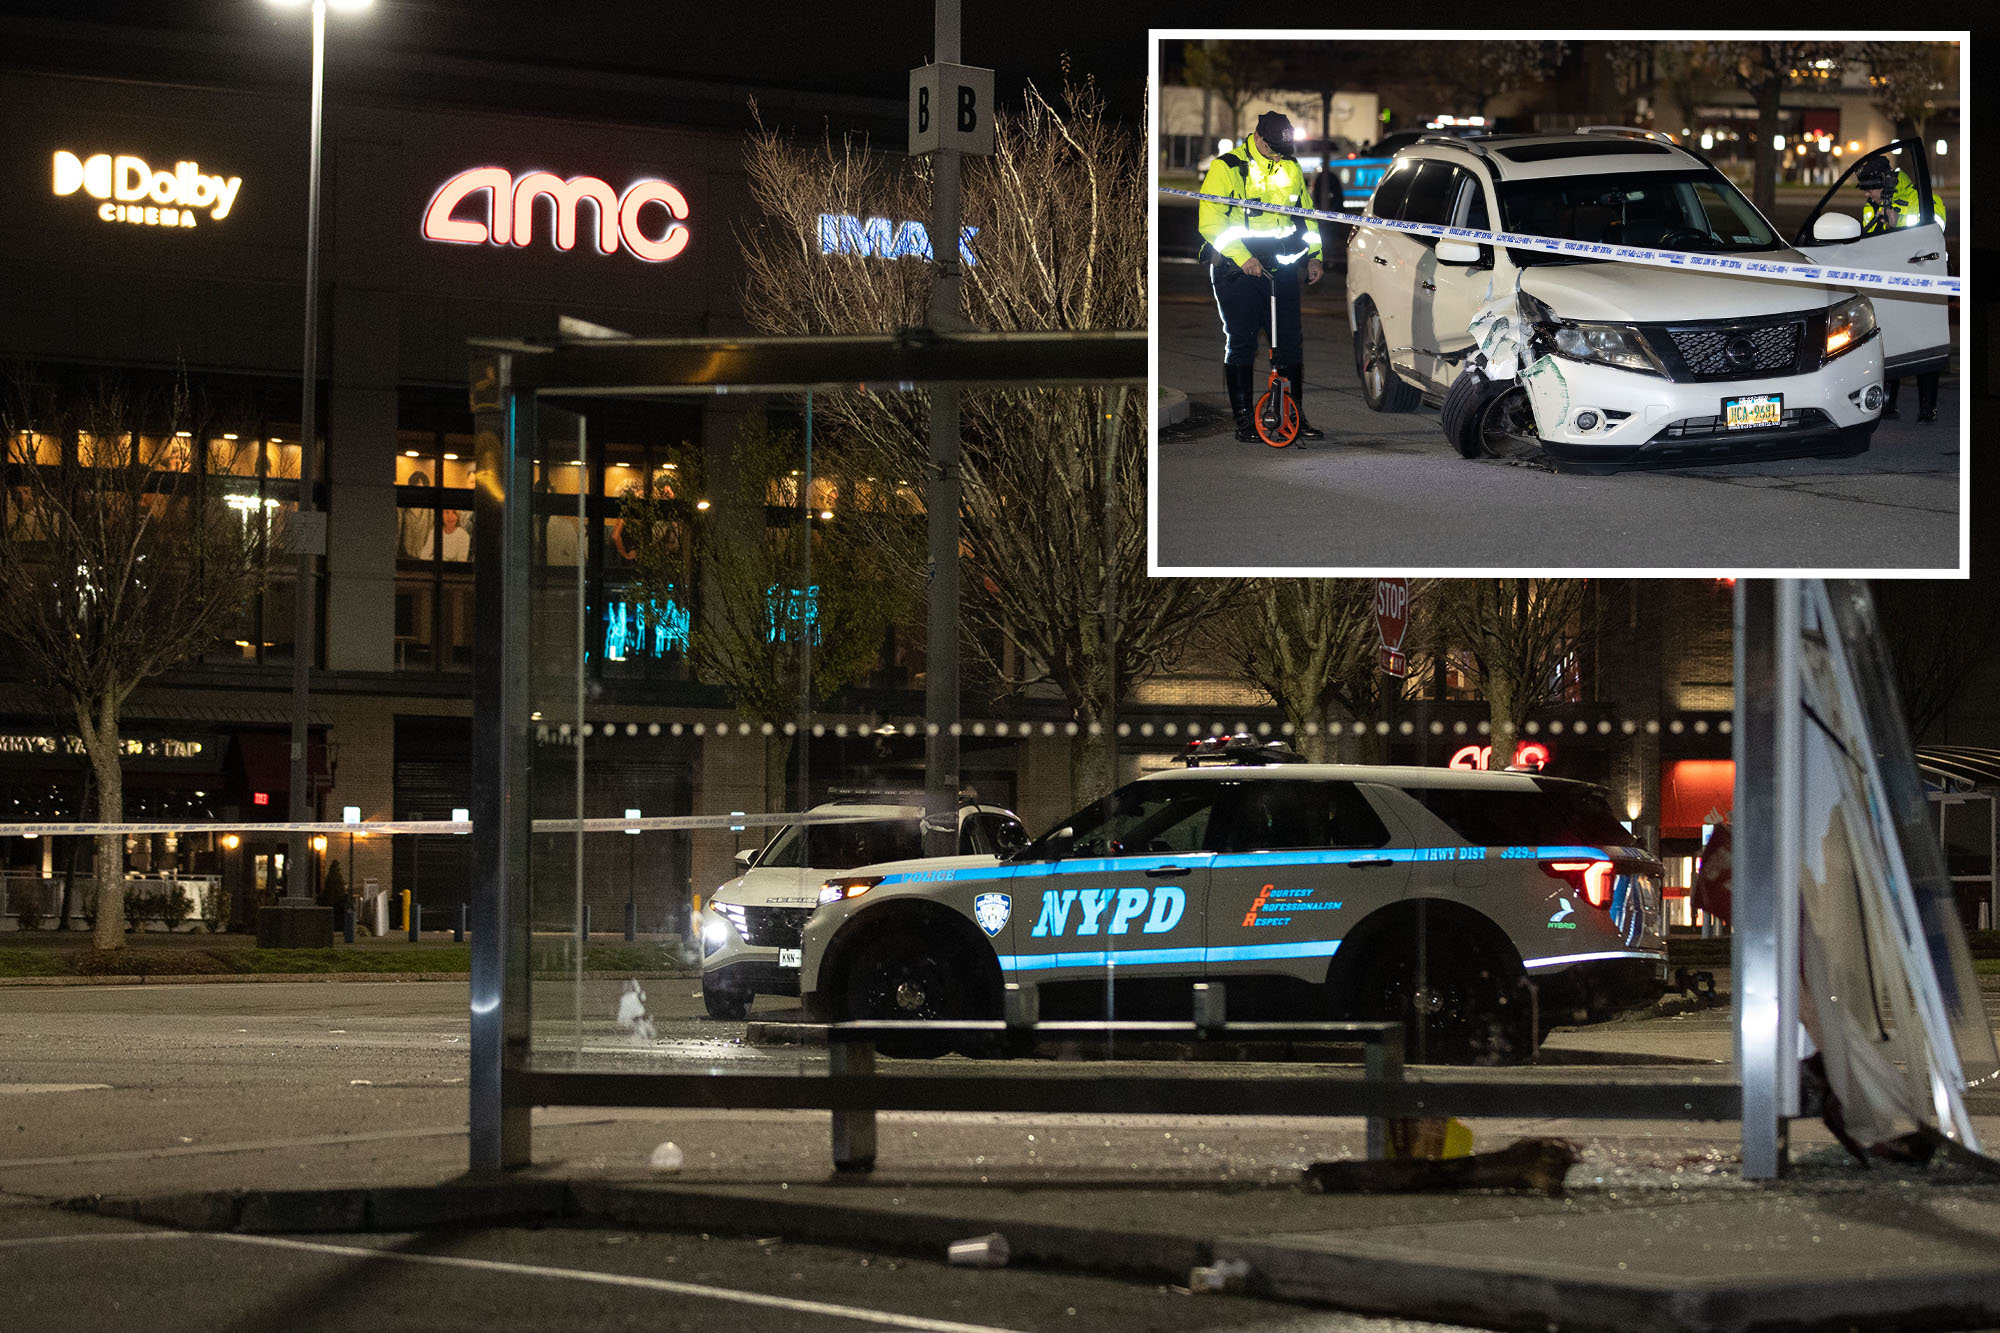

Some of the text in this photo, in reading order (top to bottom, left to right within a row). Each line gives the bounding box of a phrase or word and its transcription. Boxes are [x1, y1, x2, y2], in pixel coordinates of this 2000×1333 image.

[919, 86, 930, 134] B
[957, 85, 977, 132] B
[114, 155, 242, 220] Dolby
[98, 202, 197, 227] CINEMA
[1378, 581, 1405, 619] STOP
[162, 737, 202, 757] TAP
[1458, 846, 1487, 860] DIST
[902, 869, 956, 884] POLICE
[1259, 884, 1314, 898] COURTESY
[1031, 886, 1186, 937] NYPD
[1250, 898, 1343, 912] PROFESSIONALISM
[1242, 912, 1291, 927] RESPECT
